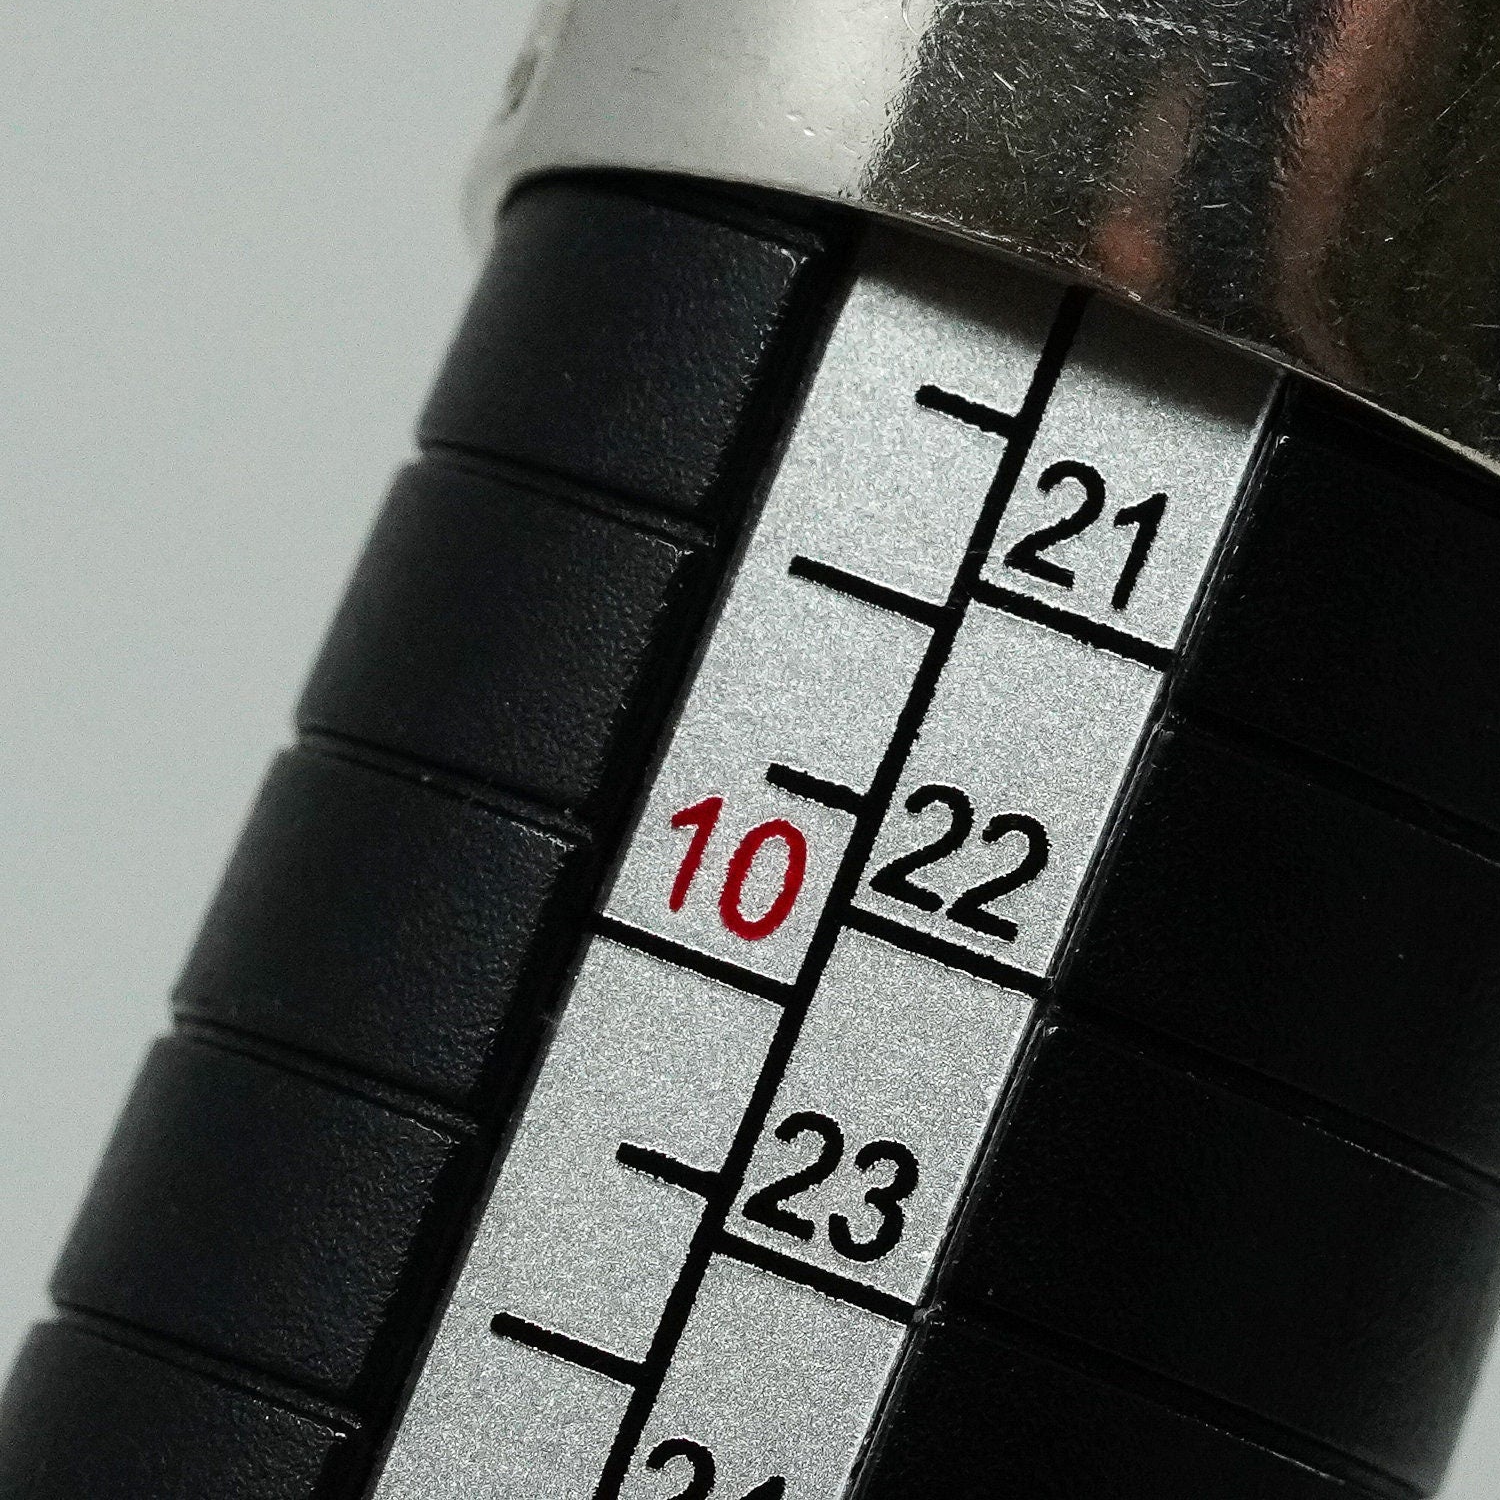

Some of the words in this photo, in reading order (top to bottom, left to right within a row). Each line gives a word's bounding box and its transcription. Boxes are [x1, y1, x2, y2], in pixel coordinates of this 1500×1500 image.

[1002, 459, 1170, 615] 21
[668, 796, 808, 944] 10
[867, 783, 1053, 945] 22
[741, 1110, 921, 1264] 23
